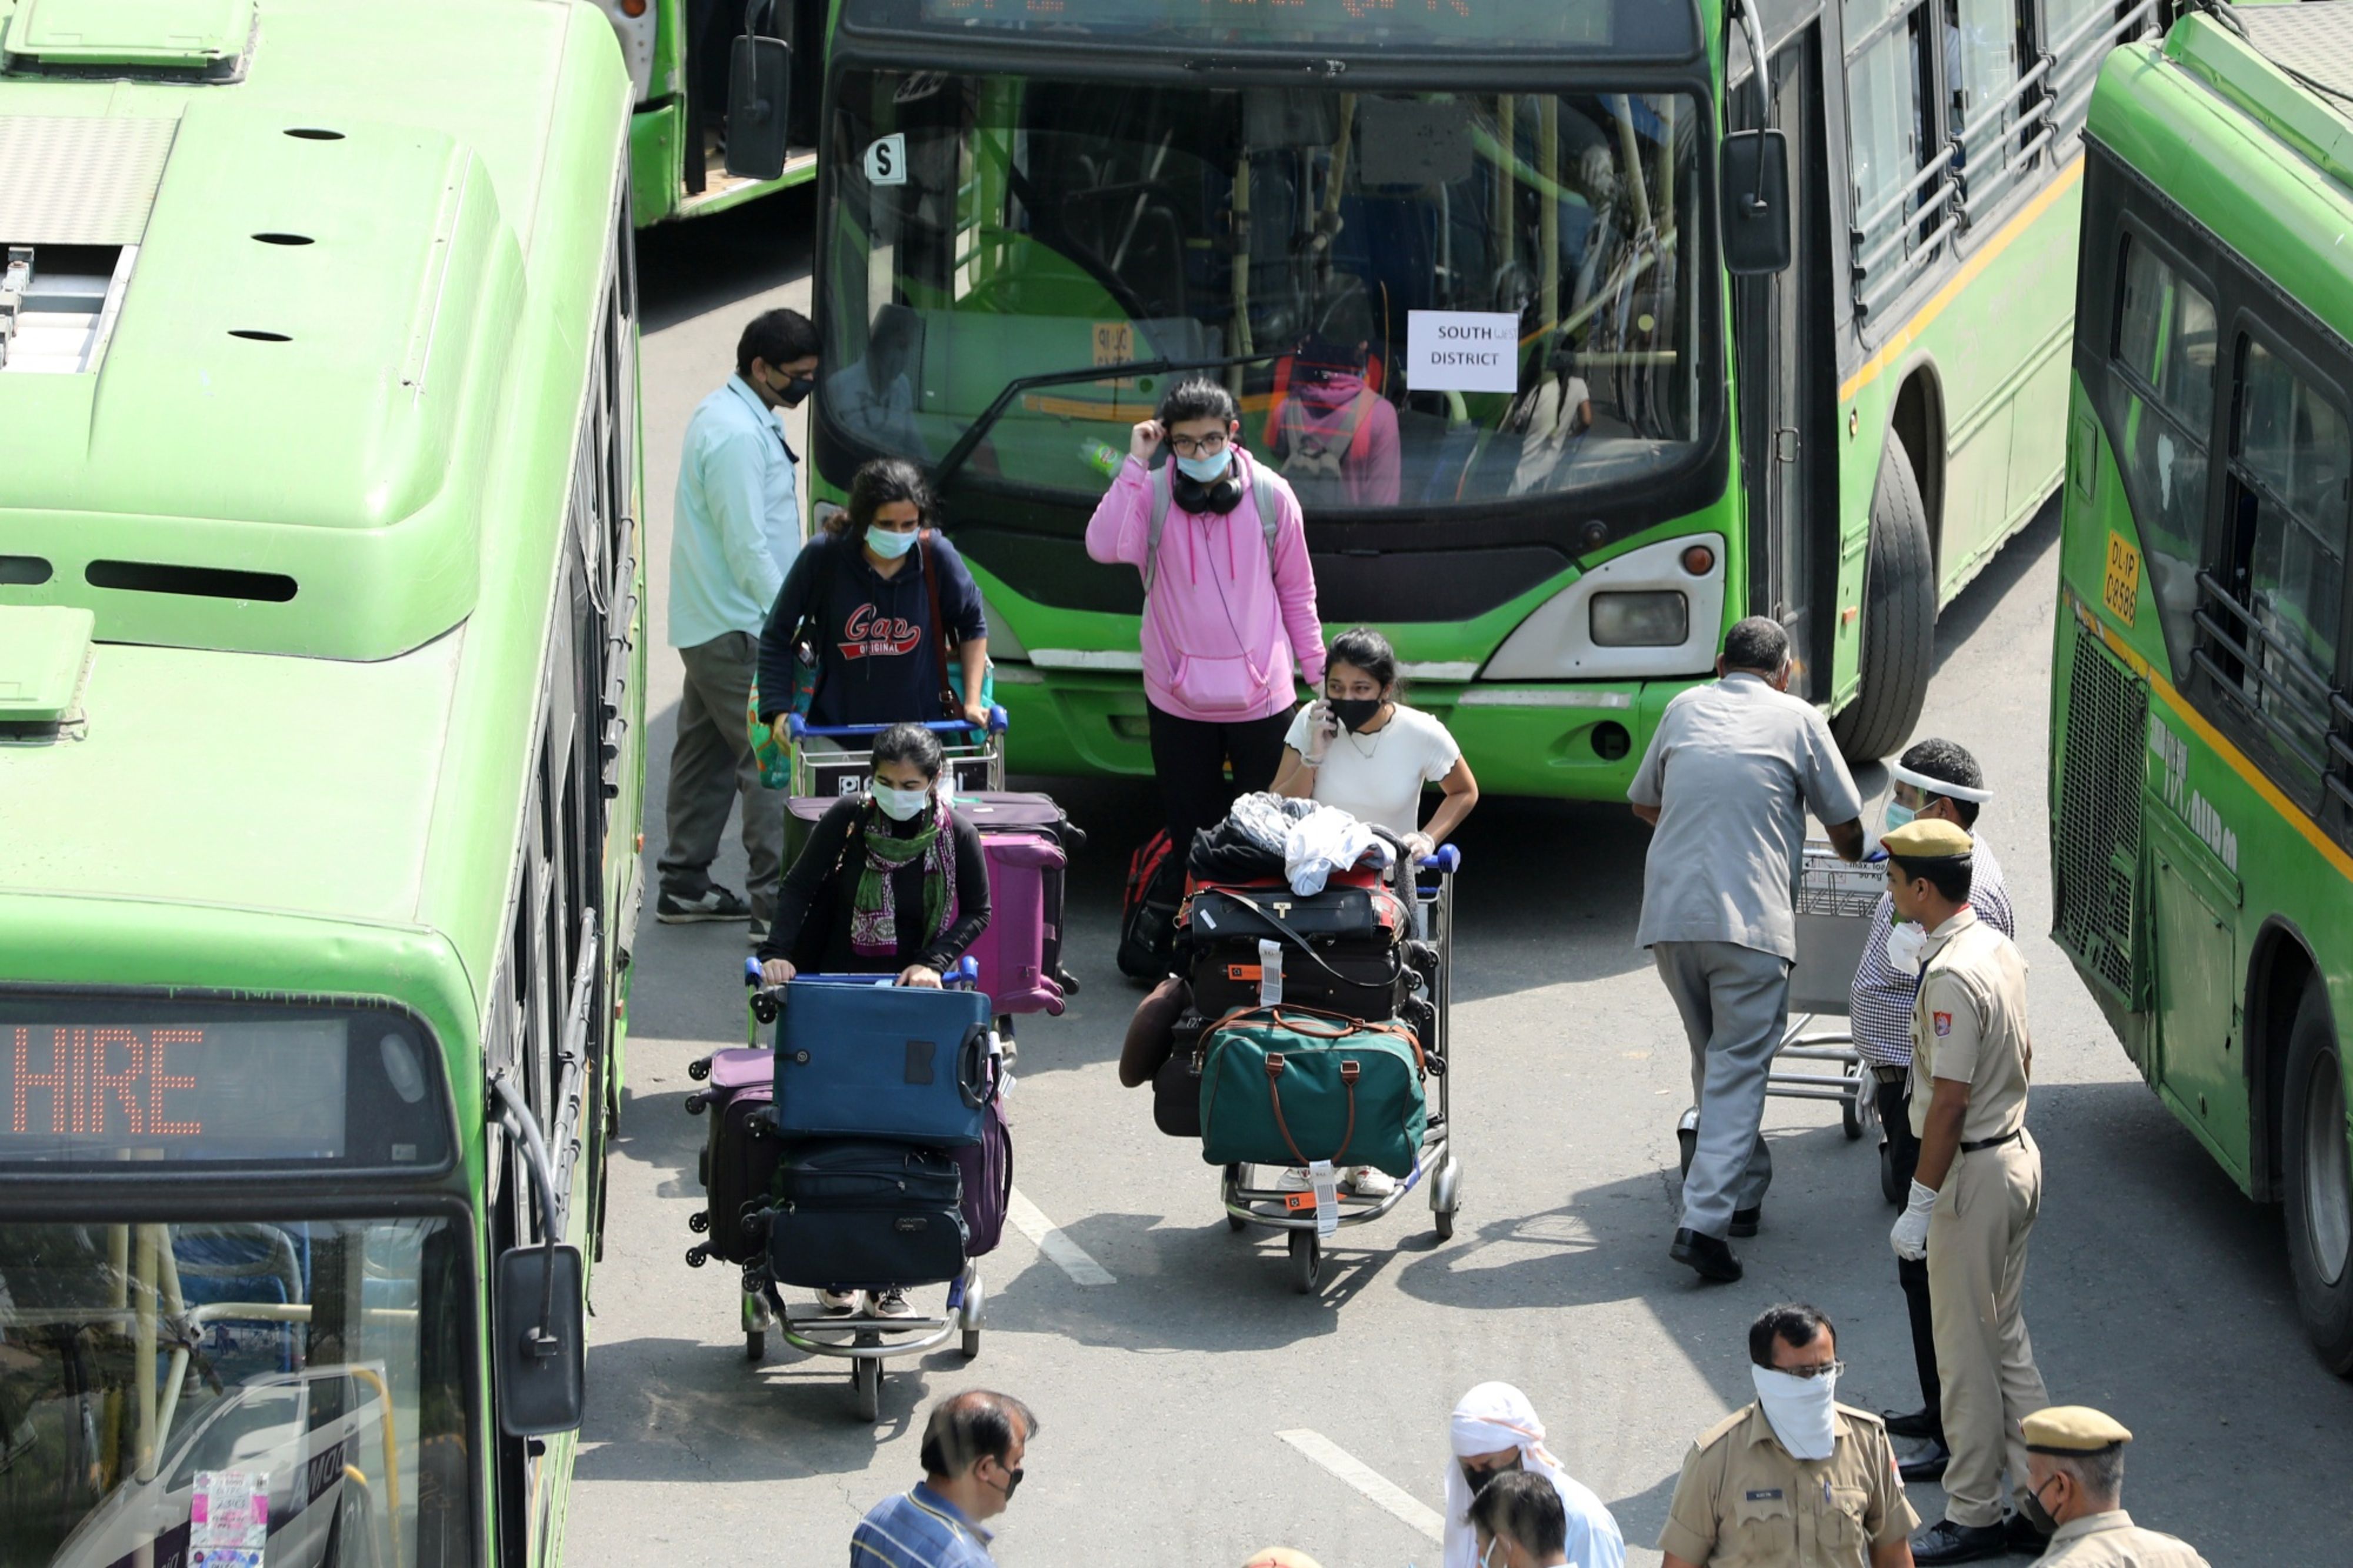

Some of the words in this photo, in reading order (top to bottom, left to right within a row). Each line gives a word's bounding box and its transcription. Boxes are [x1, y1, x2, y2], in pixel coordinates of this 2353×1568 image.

[875, 142, 892, 176] S
[1438, 326, 1491, 339] SOUTH
[1431, 352, 1499, 365] DISTRICT
[12, 1027, 204, 1134] HIRE
